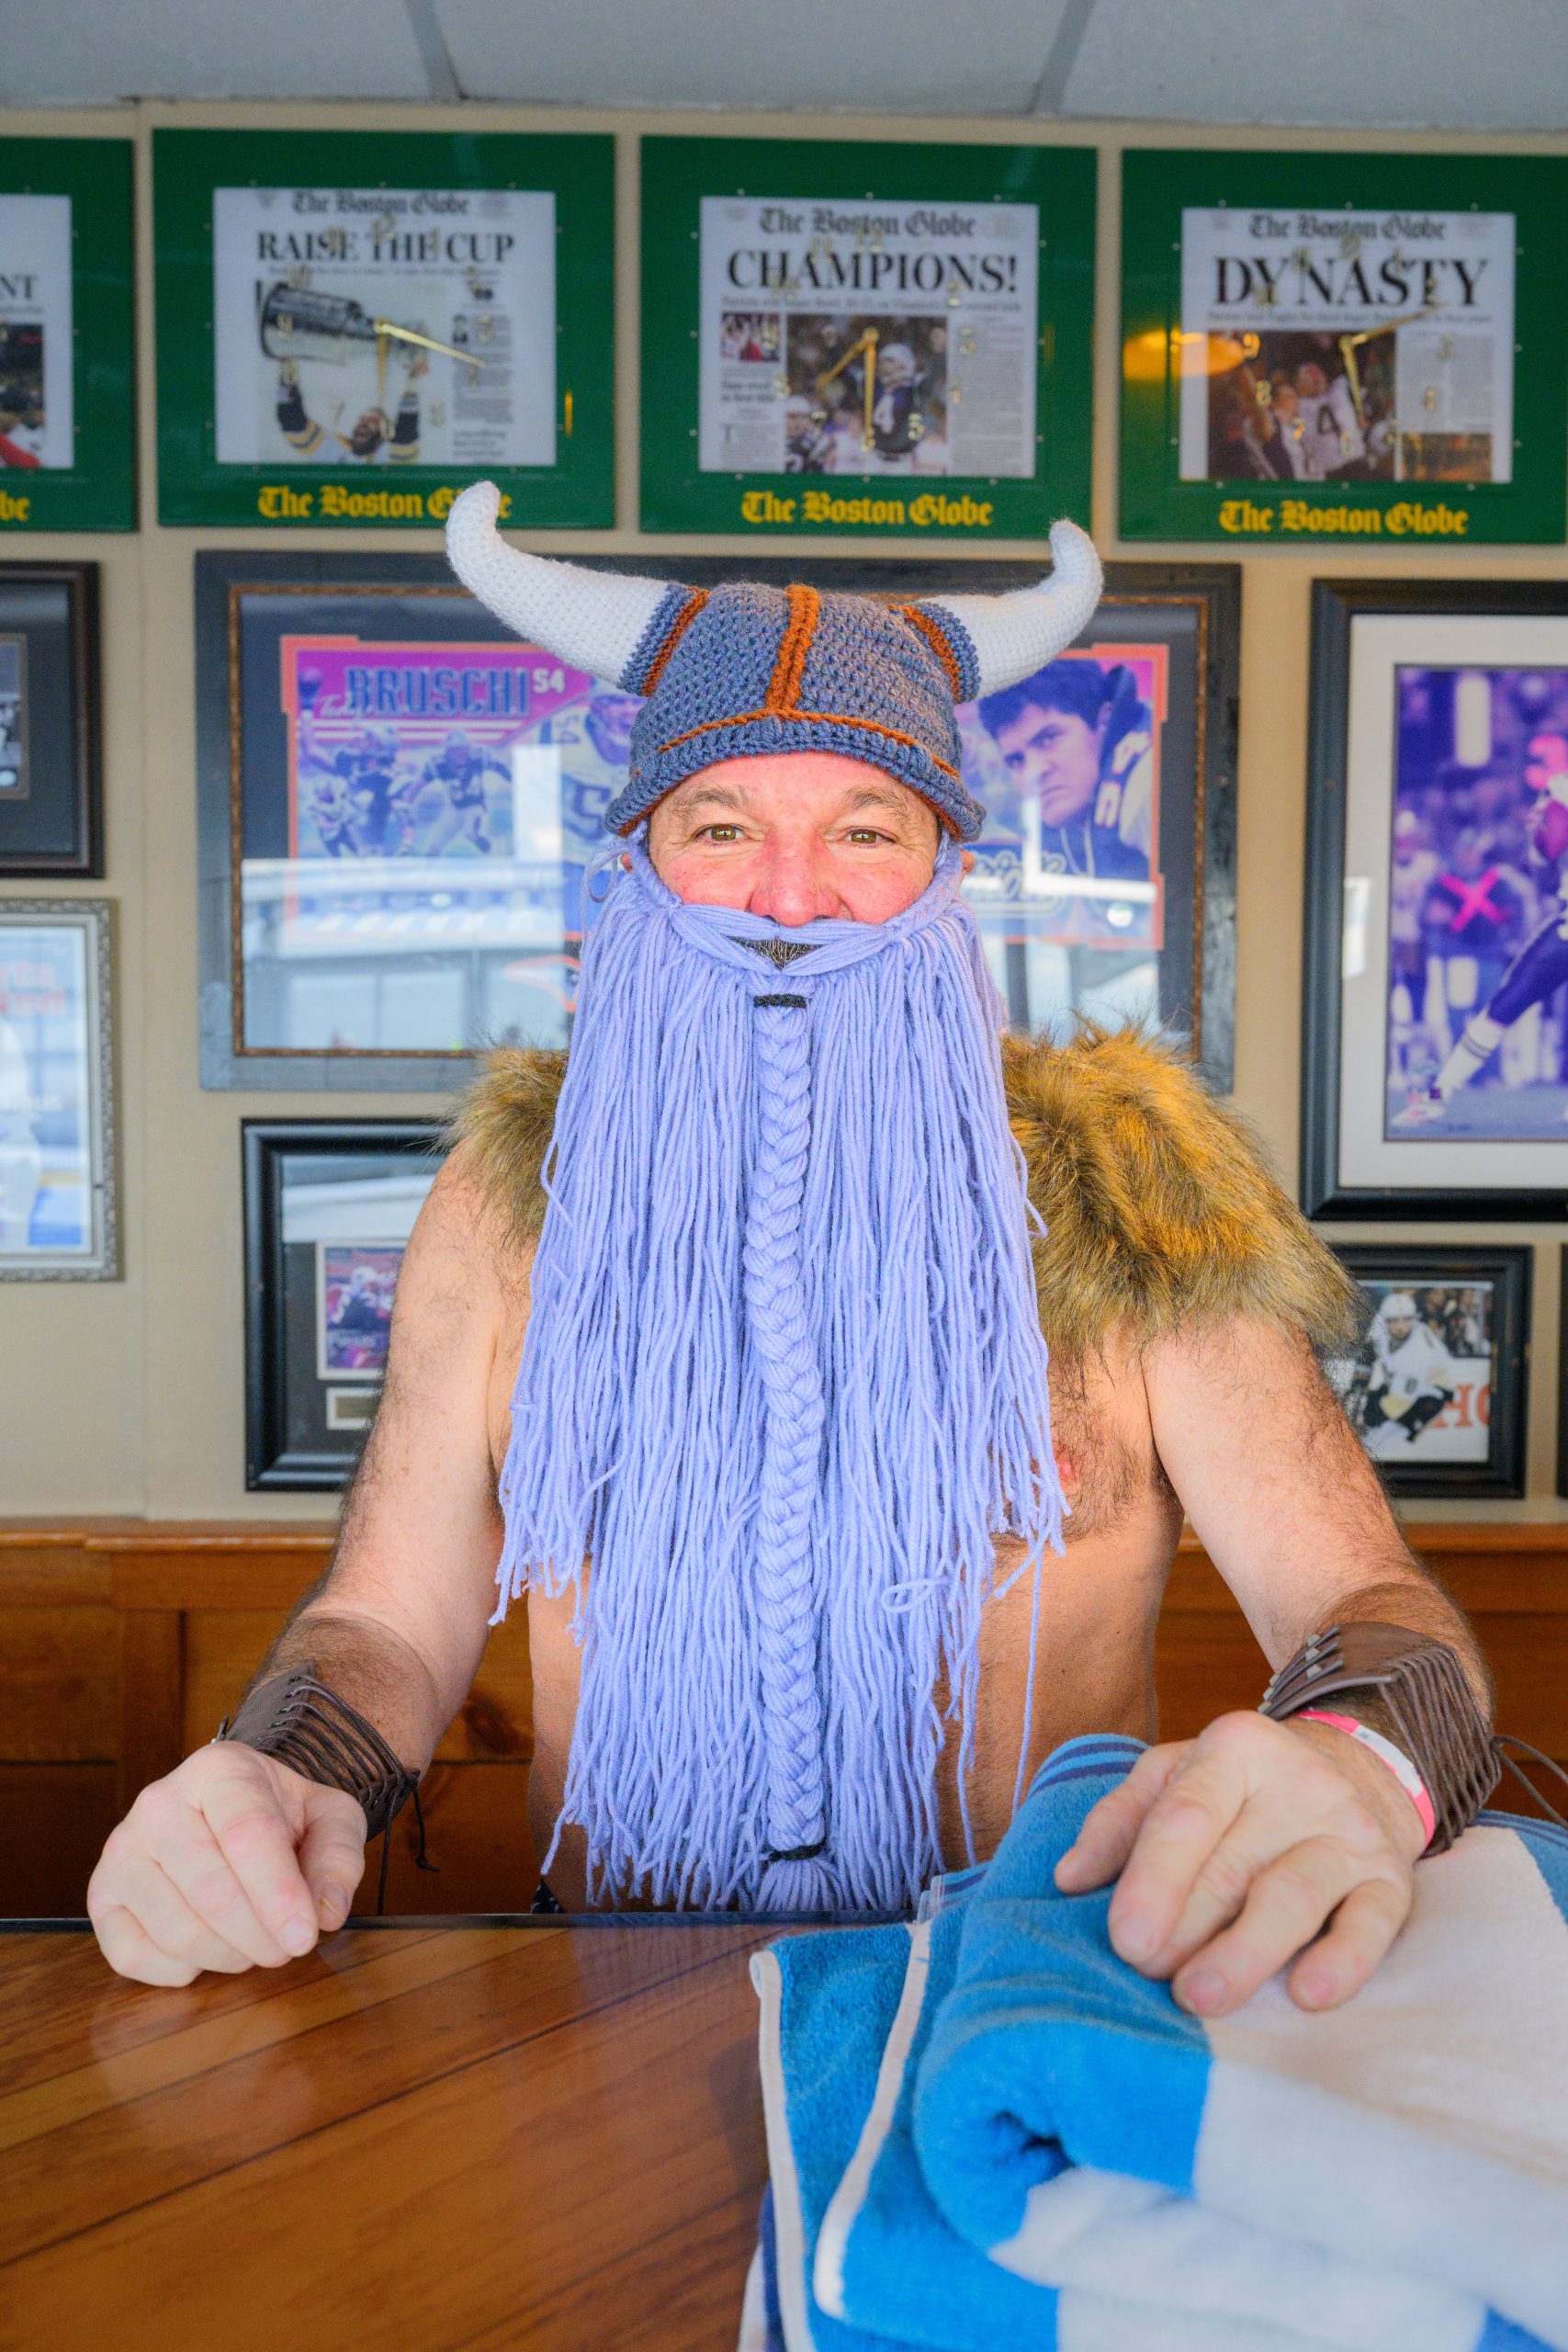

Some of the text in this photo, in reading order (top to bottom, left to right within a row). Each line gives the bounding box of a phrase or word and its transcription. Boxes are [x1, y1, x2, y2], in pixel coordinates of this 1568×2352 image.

[293, 190, 468, 214] The Boston Globe
[760, 207, 976, 237] The Boston Globe
[1249, 214, 1445, 240] The Boston Globe
[258, 232, 513, 262] RAISE THE CUP
[727, 249, 1018, 293] CHAMPIONS!
[1214, 255, 1488, 307] DYNASTY
[258, 486, 313, 518] The
[320, 485, 423, 518] Boston
[740, 491, 993, 526] The Boston Globe
[1219, 500, 1468, 535] The Boston Globe
[345, 667, 564, 718] BRUSCHI 54
